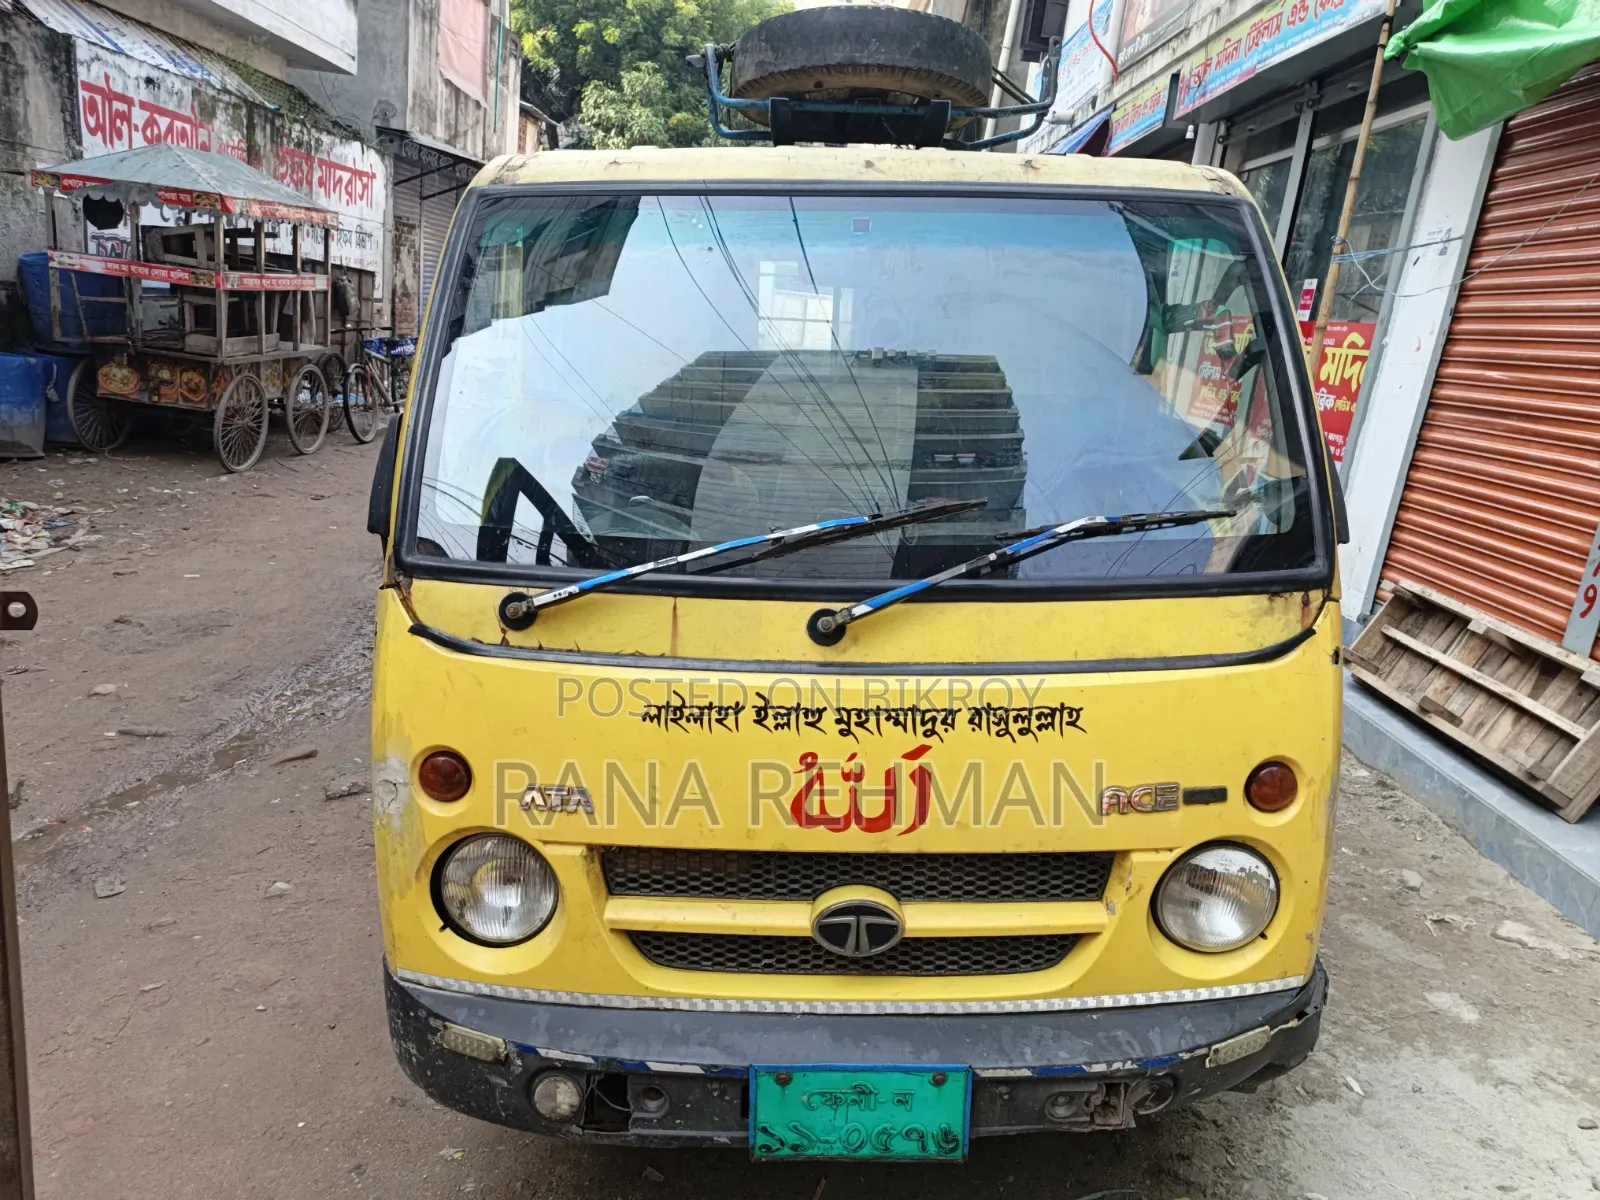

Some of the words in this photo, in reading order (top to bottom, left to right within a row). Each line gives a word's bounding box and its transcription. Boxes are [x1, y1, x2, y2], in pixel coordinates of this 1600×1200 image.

[641, 690, 746, 735] লাইলাহা
[1100, 781, 1180, 817] ACE
[757, 1121, 961, 1154] ১১-০৫৭৬
